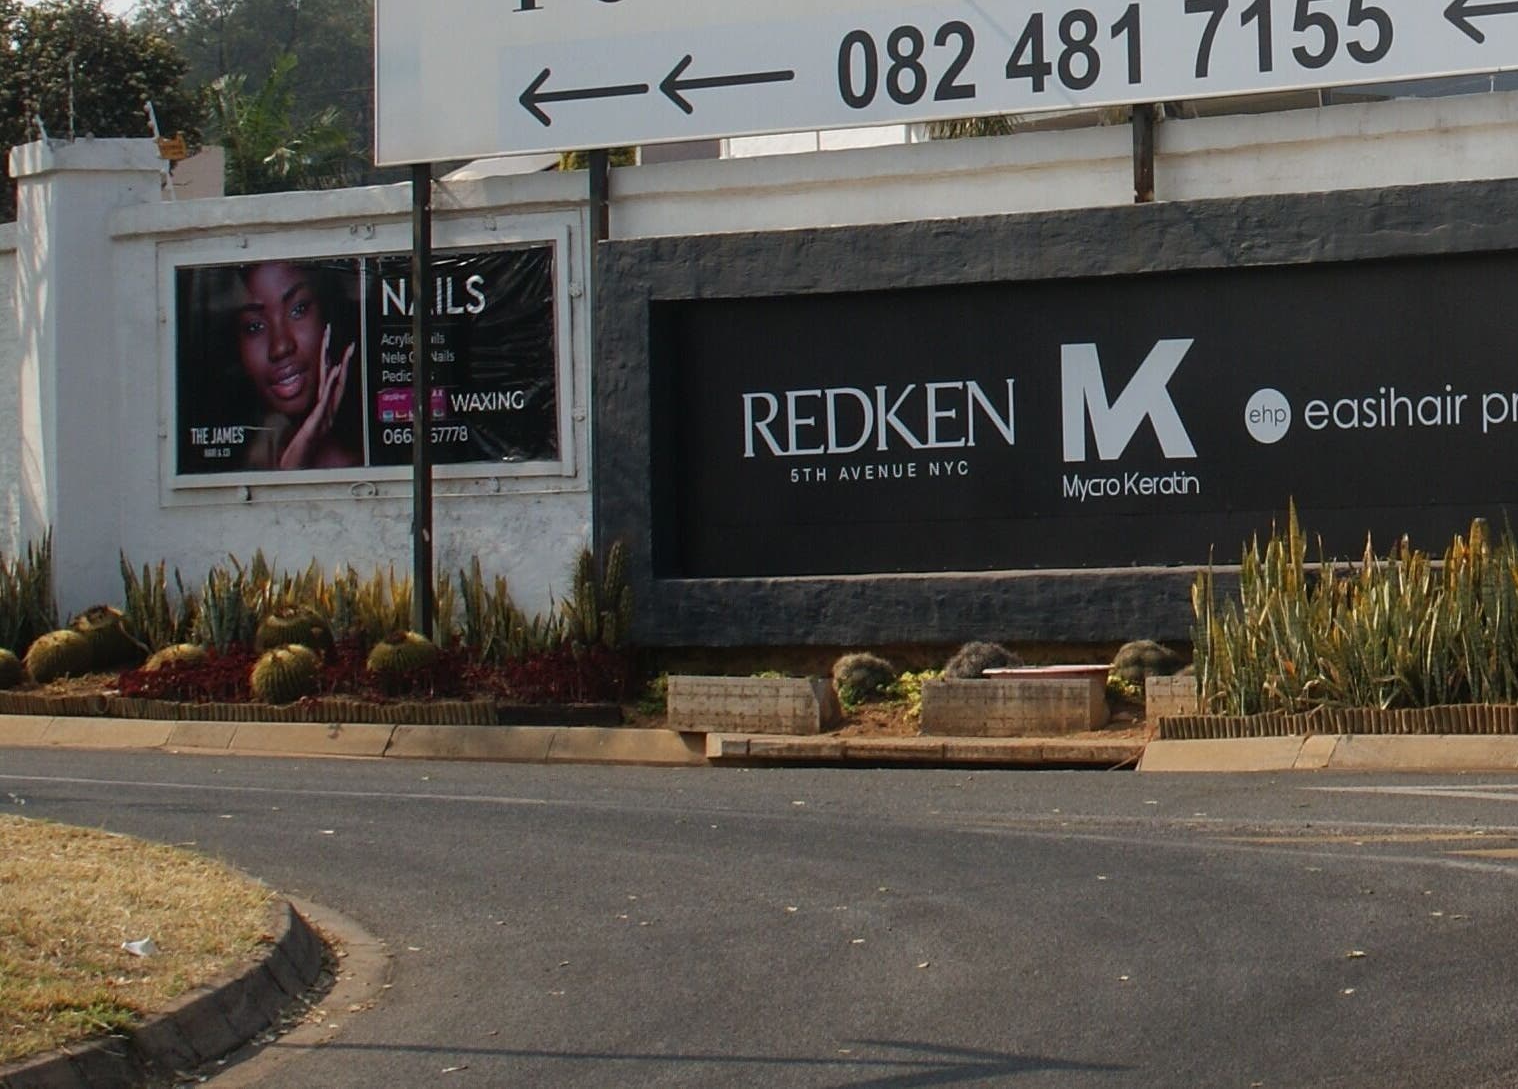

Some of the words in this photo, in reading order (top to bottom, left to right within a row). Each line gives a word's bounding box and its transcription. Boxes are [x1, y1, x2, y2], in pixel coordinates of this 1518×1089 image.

[837, 20, 977, 109] 082
[1005, 2, 1144, 93] 481
[381, 274, 487, 317] NILS
[450, 390, 526, 413] WAXING
[742, 378, 1015, 458] REDKEN
[1249, 404, 1288, 437] ehp
[1304, 383, 1468, 430] easihair
[190, 427, 209, 446] THE
[211, 426, 245, 444] JAMES
[790, 467, 827, 483] 5TH
[838, 462, 917, 481] AVENUE
[929, 460, 969, 477] NYC
[1063, 474, 1120, 503] Mycro
[1124, 471, 1201, 496] Keratin
